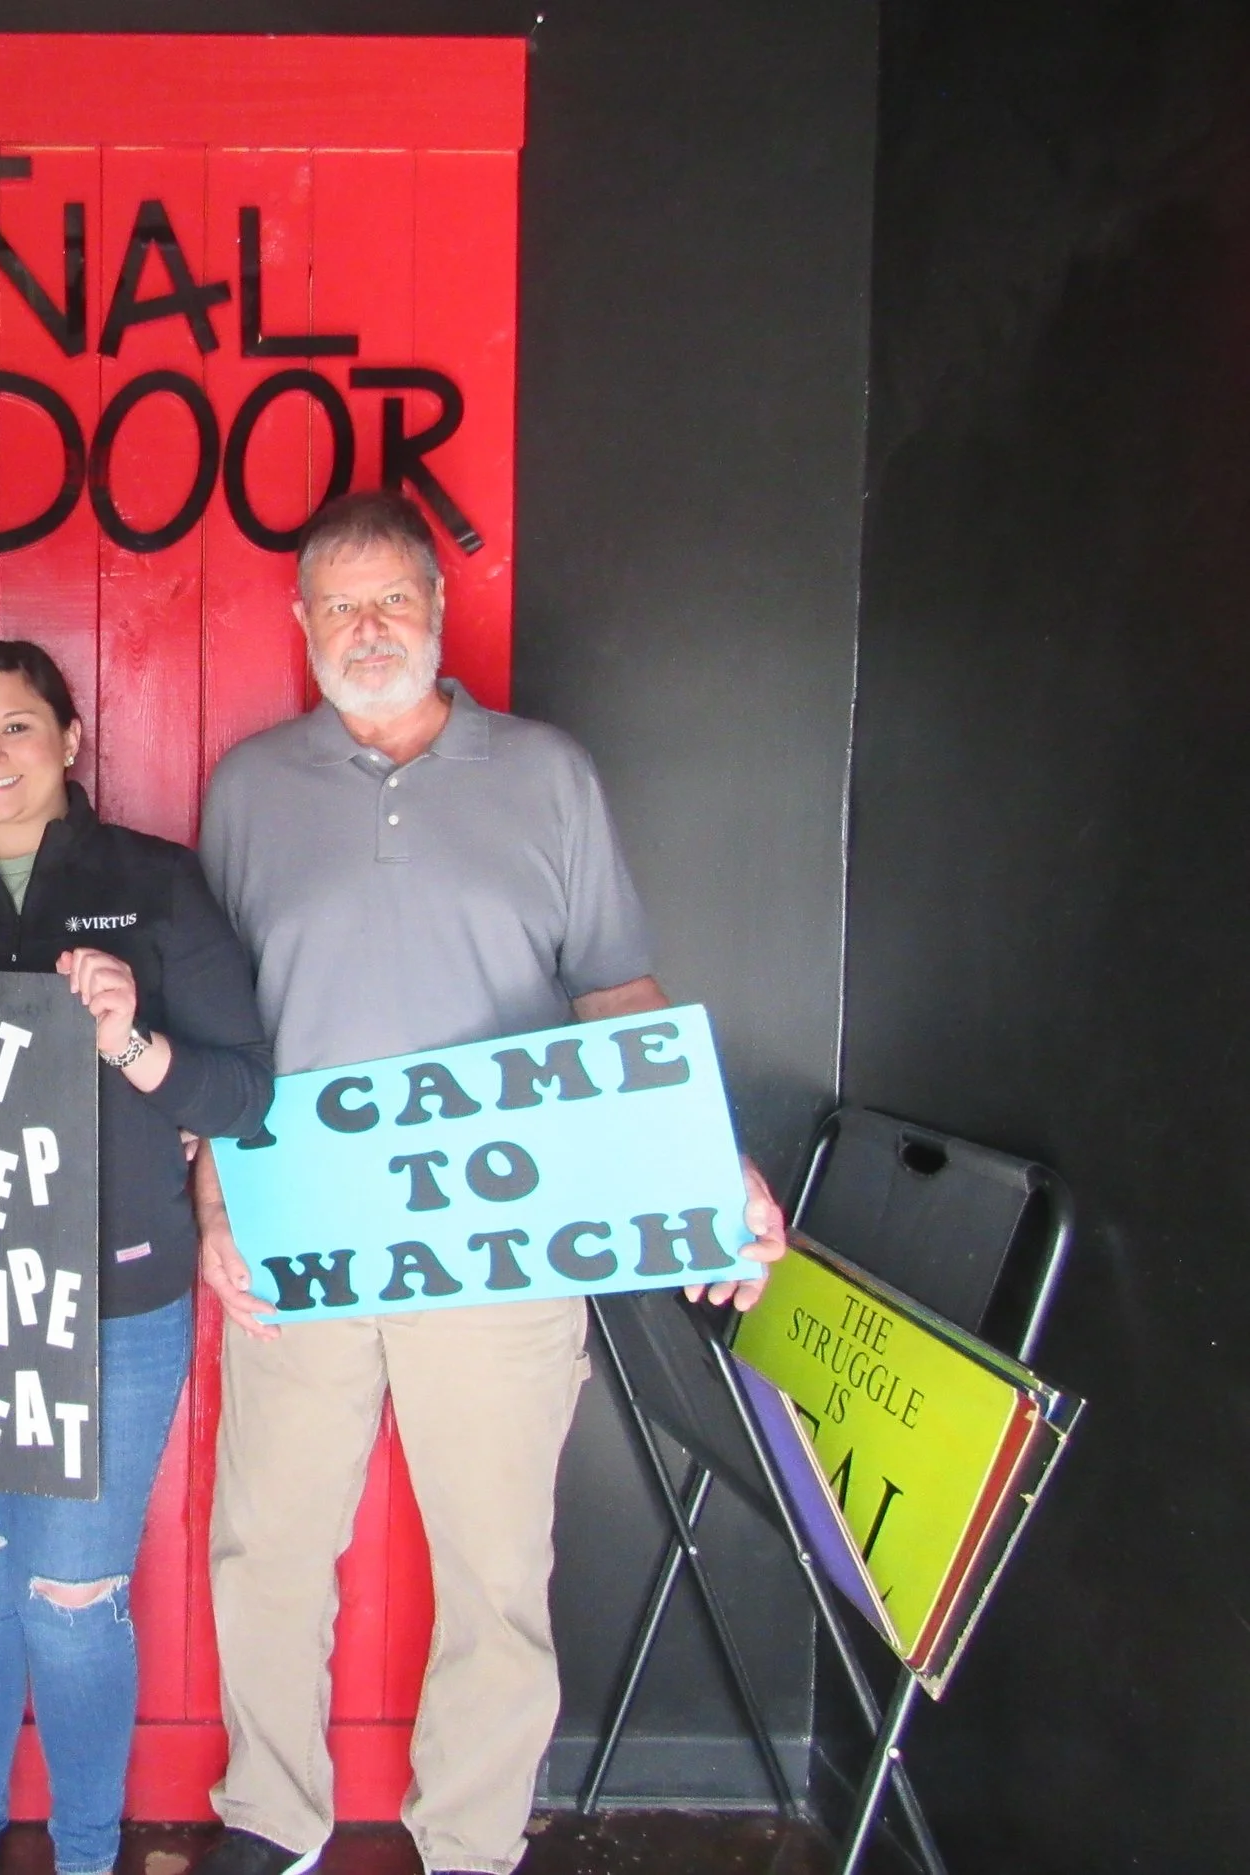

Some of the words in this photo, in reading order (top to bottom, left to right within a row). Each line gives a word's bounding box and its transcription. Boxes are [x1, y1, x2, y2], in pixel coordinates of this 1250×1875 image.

[82, 912, 137, 930] VIRTUS
[316, 1022, 691, 1134] CAME
[388, 1141, 540, 1212] TO
[261, 1207, 736, 1312] WATCH
[844, 1294, 893, 1356] THE
[787, 1307, 925, 1429] STRUGGLE
[823, 1381, 852, 1425] IS
